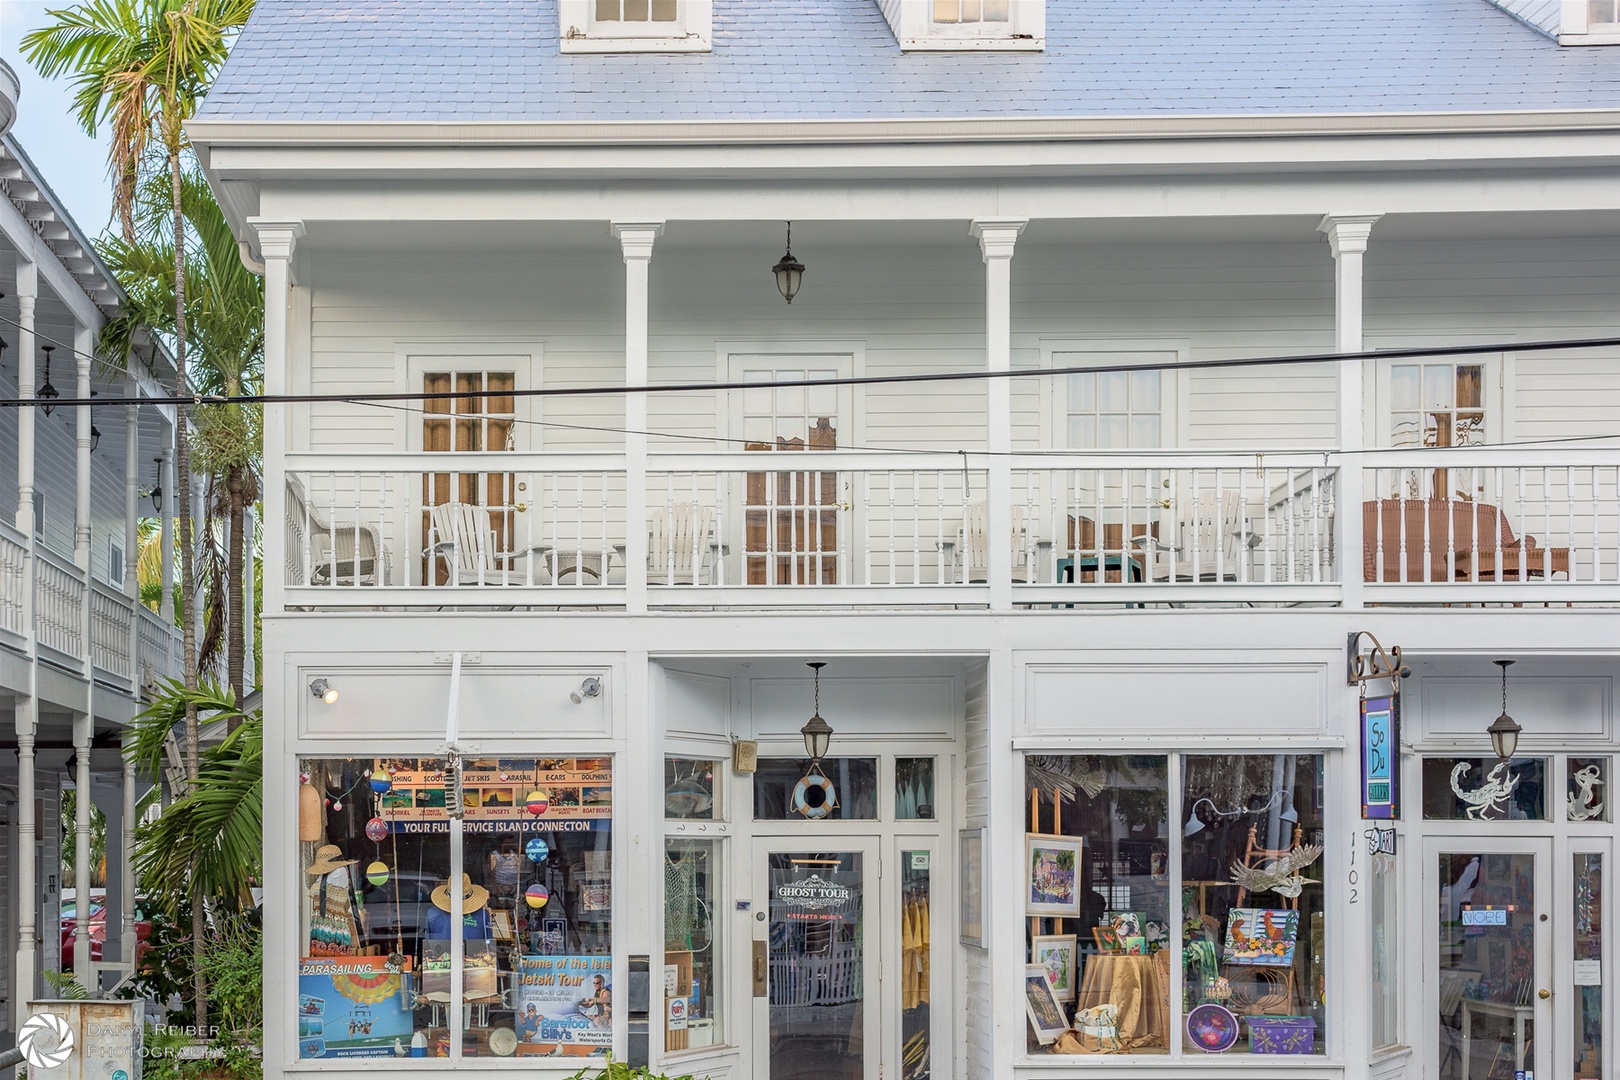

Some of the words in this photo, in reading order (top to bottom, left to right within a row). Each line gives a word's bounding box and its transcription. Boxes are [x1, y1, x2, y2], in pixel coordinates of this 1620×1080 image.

[1371, 721, 1385, 748] So
[1371, 748, 1385, 774] Du
[1368, 783, 1390, 802] GALLERY
[404, 823, 431, 833] YOUR
[432, 823, 450, 833] FUL
[462, 822, 494, 832] ERVICE
[495, 821, 529, 832] ISLAND
[531, 821, 590, 831] CONNECTON
[1381, 831, 1393, 852] ART
[778, 887, 816, 897] GHOST
[818, 888, 849, 899] TOUR
[301, 963, 373, 975] PARASAILING
[519, 957, 553, 969] Home
[555, 957, 568, 969] of
[569, 957, 588, 969] the
[518, 972, 555, 986] Jetski
[557, 973, 584, 987] Tour
[541, 1017, 590, 1029] Barefoot
[541, 1029, 572, 1040] Billy's
